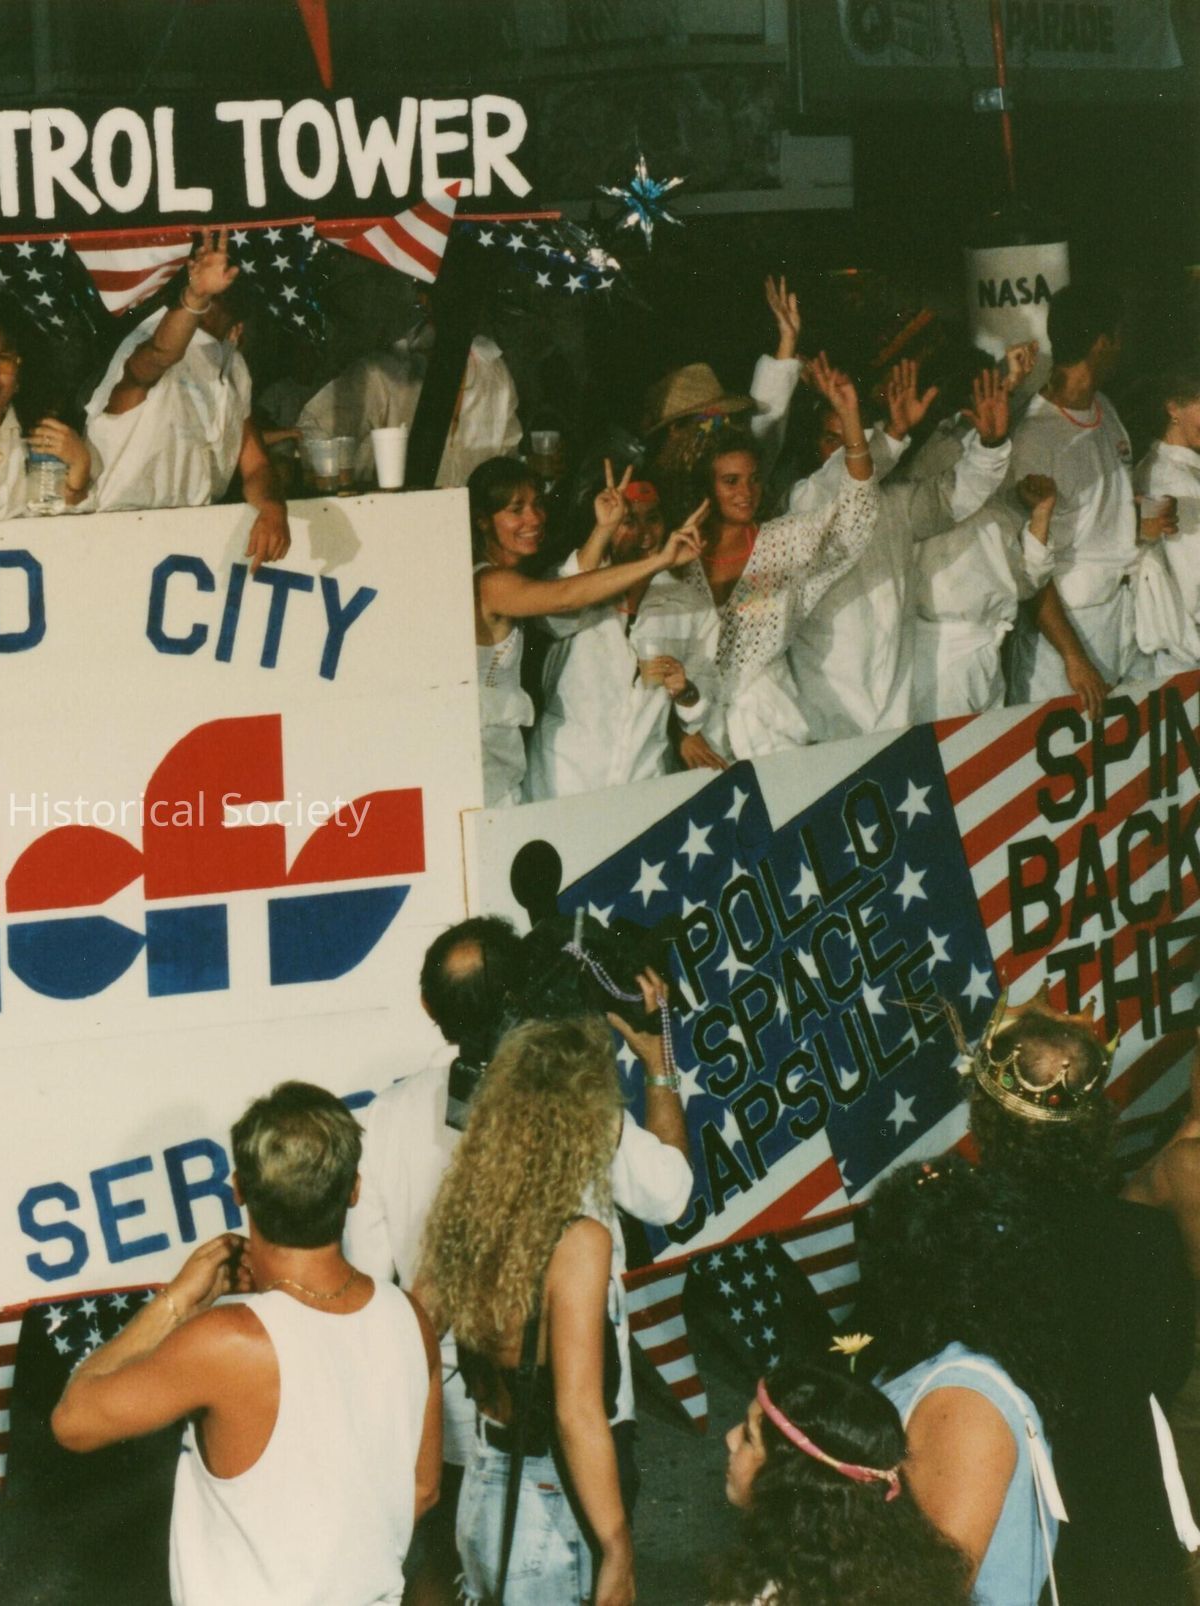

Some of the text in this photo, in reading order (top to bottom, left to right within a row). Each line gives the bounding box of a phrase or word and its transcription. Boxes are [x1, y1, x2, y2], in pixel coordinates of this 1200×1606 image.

[215, 94, 533, 208] TOWER
[978, 273, 1053, 308] NASA
[146, 554, 377, 681] CITY
[1035, 686, 1200, 824] SPIN
[674, 779, 897, 1013] POLLO
[1007, 803, 1200, 956] BACK
[692, 873, 907, 1099] SPACE
[1046, 915, 1200, 1042] THE
